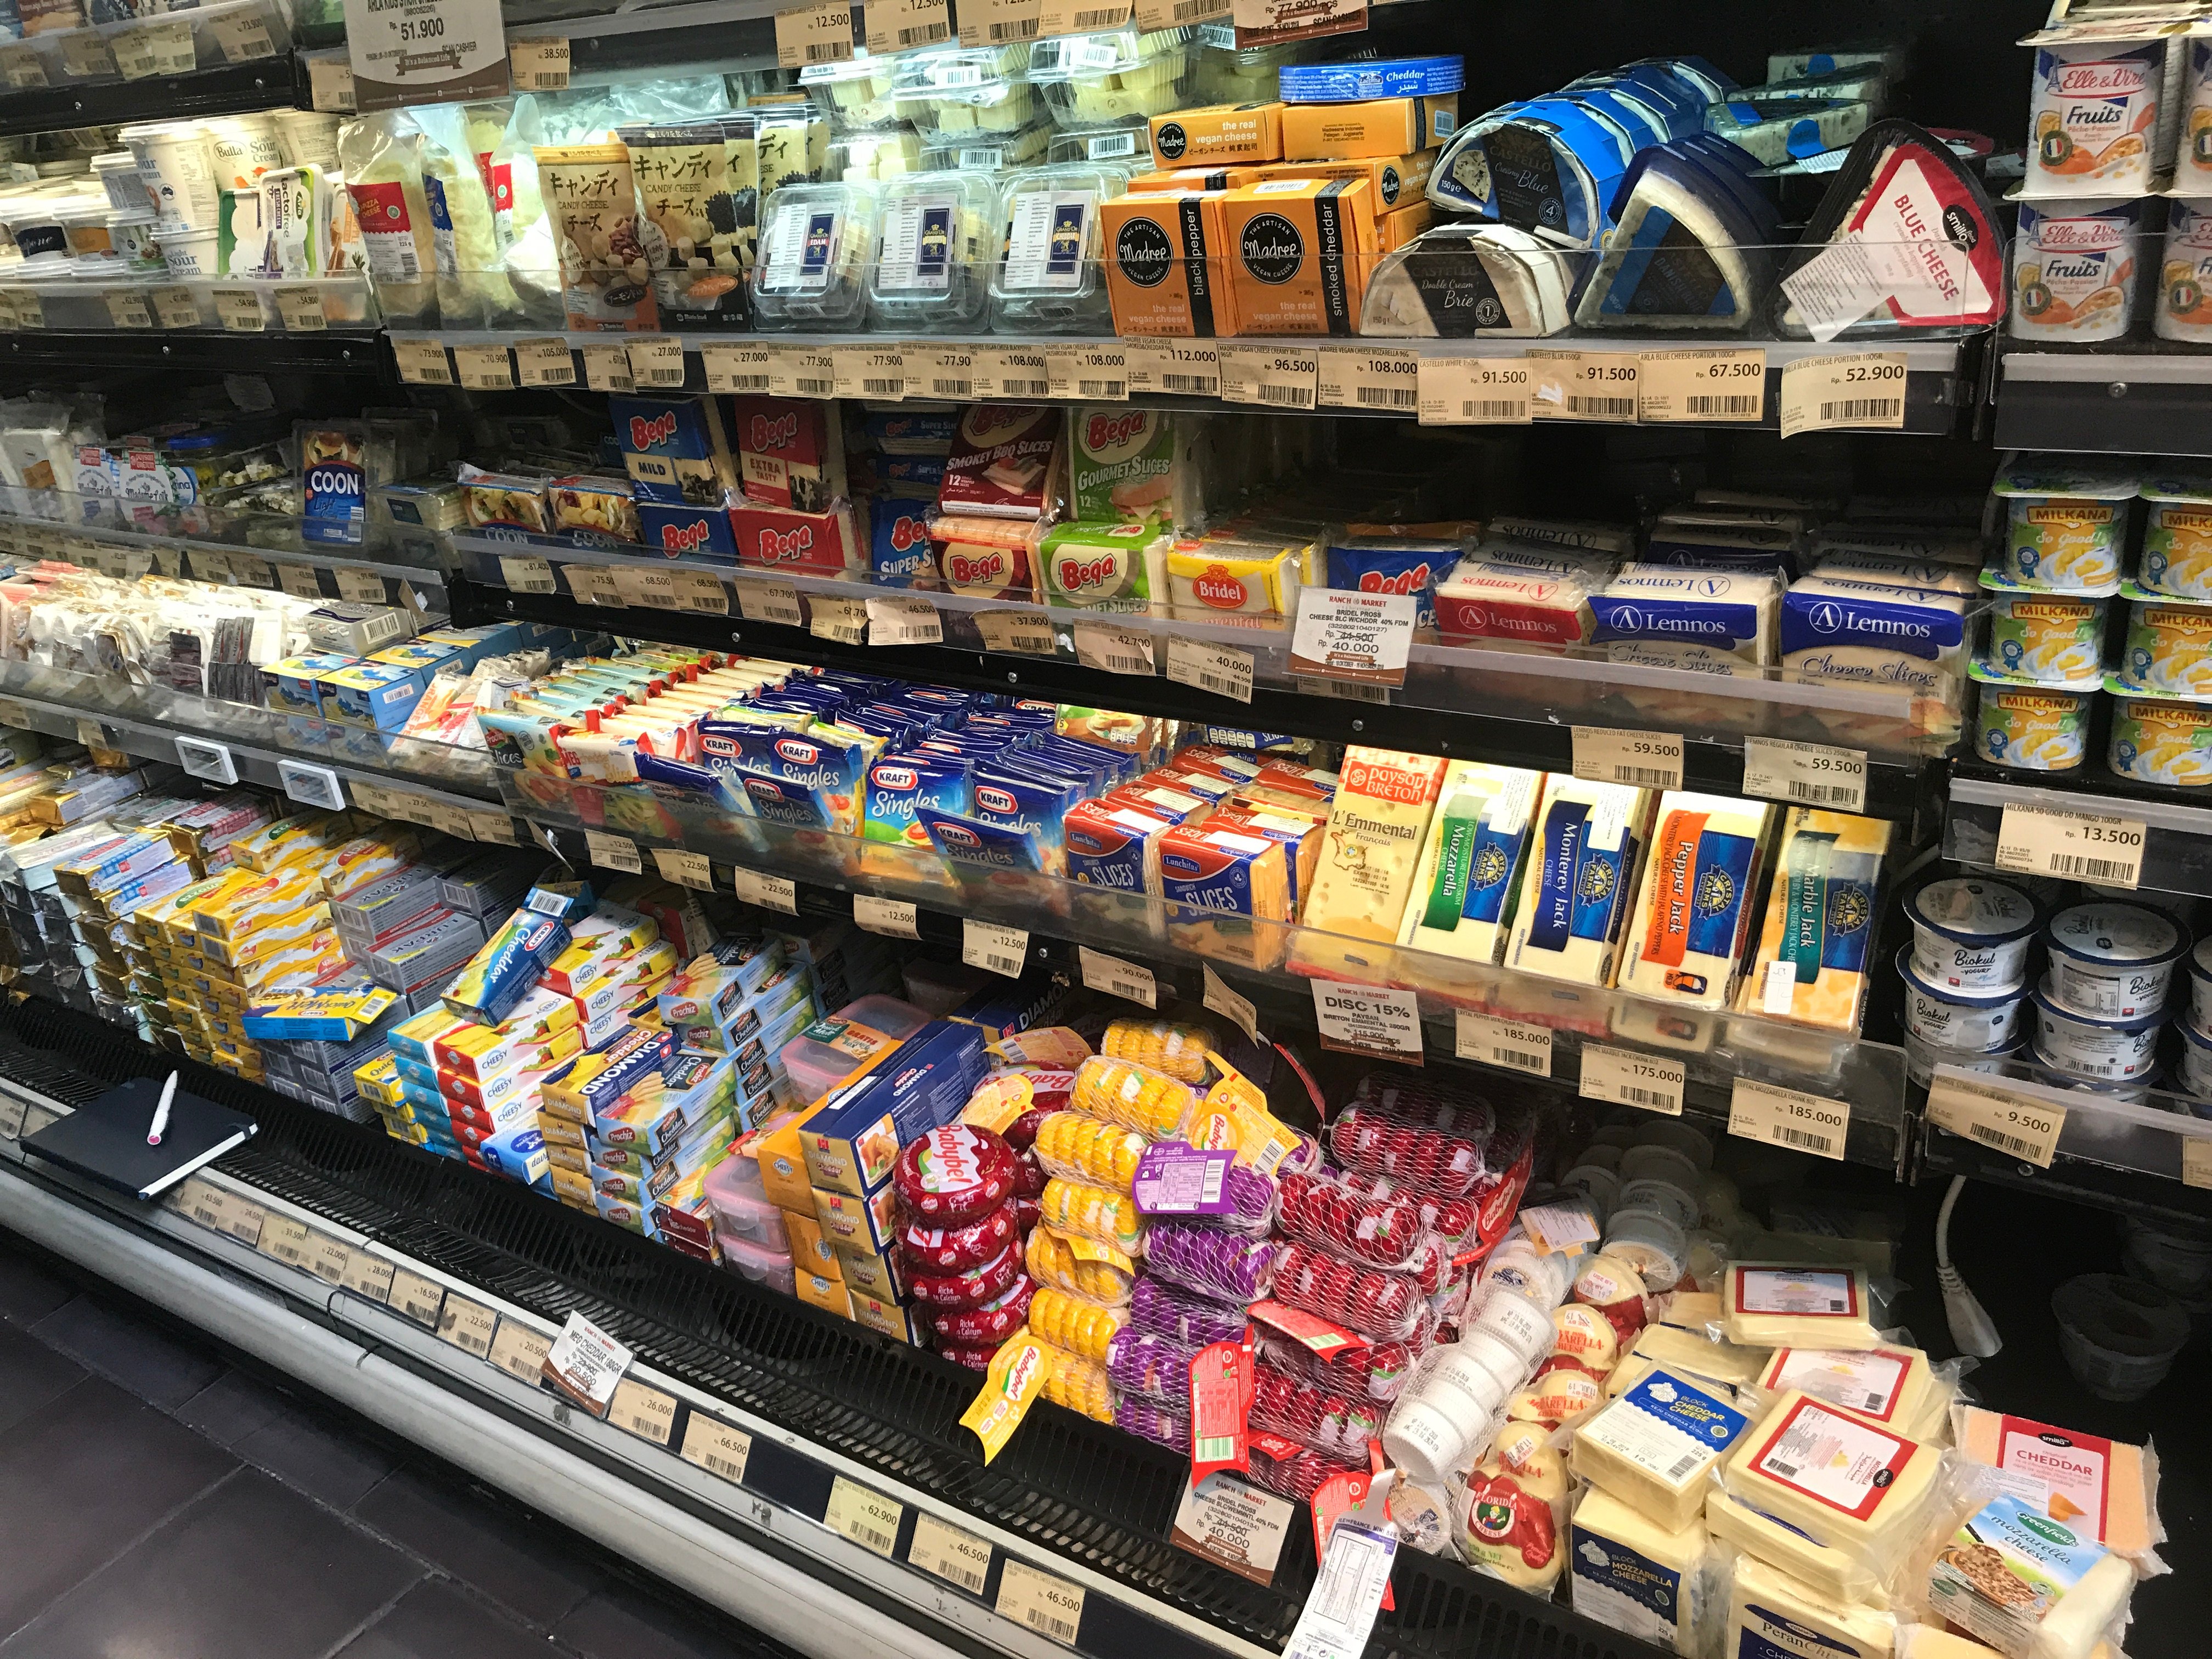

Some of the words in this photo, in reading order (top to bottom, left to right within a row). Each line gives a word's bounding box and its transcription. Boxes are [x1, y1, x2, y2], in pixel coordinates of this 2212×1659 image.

[400, 17, 444, 41] 51.900
[815, 13, 849, 27] 12.500
[544, 48, 568, 59] 38.500
[1386, 70, 1425, 81] Cheddar
[2067, 105, 2123, 125] Fruits
[1222, 120, 1237, 129] the
[1239, 120, 1257, 129] real
[1158, 136, 1184, 148] Madree
[1195, 133, 1223, 144] vegan
[1224, 131, 1257, 141] cheese
[216, 141, 243, 156] Bulla
[634, 151, 712, 180] キャンディ
[550, 172, 620, 196] キャンディ
[646, 184, 672, 193] CANDY
[675, 184, 701, 192] CHEESE
[1519, 171, 1548, 194] Blue
[657, 198, 695, 217] チーズ
[568, 213, 602, 231] チーズ
[1186, 210, 1204, 257] pepper
[1323, 204, 1341, 261] cheddar
[1119, 240, 1171, 260] Madree
[1894, 194, 1923, 238] BLUE
[1918, 236, 1960, 301] CHEESE
[168, 255, 198, 267] Sour
[2046, 259, 2100, 278] Fruits
[1185, 257, 1204, 296] black
[1422, 279, 1446, 290] Double
[1449, 280, 1474, 290] Cream
[1323, 263, 1343, 316] smoked
[1444, 291, 1474, 308] Brie
[423, 349, 443, 359] 73.900
[486, 355, 507, 363] 70.900
[542, 347, 569, 357] 105.000
[741, 352, 768, 362] 27.000
[873, 356, 902, 366] 77.900
[1008, 355, 1043, 367] 108.000
[1170, 349, 1216, 362] 112.000
[1274, 358, 1314, 373] 96.500
[1368, 360, 1417, 374] 108.000
[1587, 367, 1636, 381] 91.500
[1709, 363, 1760, 377] 67.500
[1846, 365, 1904, 381] 52.900
[1482, 371, 1527, 383] 91.500
[630, 410, 676, 451] Bega
[638, 461, 665, 476] MILD
[750, 458, 781, 475] EXTRA
[311, 471, 358, 495] COON
[755, 471, 777, 482] TASTY
[2036, 509, 2107, 521] MILKANA
[1059, 554, 1116, 590] Bega
[1198, 579, 1242, 601] Bridel
[1361, 599, 1386, 607] MARKET
[2019, 605, 2090, 617] MILKANA
[1017, 617, 1047, 626] 37.900
[1328, 623, 1387, 633] (3228021040127)
[1491, 614, 1556, 634] Lemnos
[1645, 614, 1726, 634] Lemnos
[1847, 611, 1931, 639] Lemnos
[1332, 642, 1379, 653] 40.000
[1217, 656, 1251, 674] 40.000
[1801, 655, 1873, 678] Cheese
[1881, 662, 1937, 686] Slices
[2006, 697, 2073, 709] MILKANA
[2135, 708, 2207, 723] MILKANA
[705, 740, 737, 754] KRAFT
[782, 744, 813, 759] KRAFT
[1634, 742, 1679, 757] 59.500
[1811, 758, 1862, 775] 59.500
[782, 764, 839, 788] Singles
[878, 770, 913, 786] KRAFT
[872, 791, 940, 817] Singles
[979, 792, 1014, 809] KRAFT
[1332, 810, 1417, 840] L'Emmental
[1071, 834, 1101, 848] Lunchitas
[1356, 832, 1391, 845] Français
[2083, 827, 2141, 845] 13.500
[1165, 857, 1199, 871] Lunchitas
[1442, 825, 1459, 896] Mozzarella
[1556, 822, 1578, 893] Monterey
[1093, 864, 1134, 886] SLICES
[1673, 840, 1694, 896] Pepper
[768, 884, 792, 896] 22.500
[1803, 864, 1819, 912] Marble
[889, 912, 915, 923] 12.500
[1553, 898, 1568, 928] Jack
[1668, 899, 1687, 934] Jack
[1799, 916, 1815, 947] Jack
[1000, 937, 1025, 950] 12.500
[488, 928, 532, 983] Cheddar
[1954, 950, 1996, 966] Biokul
[575, 965, 598, 985] CHEESY
[1122, 968, 1153, 981] 90.000
[670, 1005, 696, 1015] Prochiz
[1325, 996, 1367, 1011] DISC
[1373, 1004, 1410, 1018] 15%
[1917, 999, 1950, 1023] Biokul
[1504, 1028, 1549, 1046] 185.000
[482, 1051, 507, 1071] CHEESY
[580, 1041, 661, 1097] DIAMOND
[1633, 1064, 1682, 1084] 175.000
[487, 1077, 512, 1098] CHEESY
[1736, 1081, 1754, 1091] CRYTAL
[1755, 1086, 1787, 1098] MOZZARELLA
[1788, 1094, 1805, 1103] CHUNK
[546, 1098, 582, 1114] DIAMOND
[1788, 1105, 1841, 1126] 185.000
[2008, 1111, 2051, 1133] 9.500
[609, 1131, 633, 1141] Prochiz
[808, 1150, 847, 1166] DIAMOND
[936, 1126, 973, 1183] Babybel
[371, 1265, 392, 1279] 28.000
[470, 1315, 492, 1331] 22.500
[523, 1341, 547, 1358] 20.500
[568, 1330, 581, 1344] MEG
[580, 1336, 605, 1362] CHEDDAR
[604, 1357, 622, 1374] 180GR
[1010, 1346, 1036, 1400] Babybel
[647, 1400, 672, 1416] 26.000
[1674, 1401, 1725, 1420] CHEDDAR
[1681, 1396, 1708, 1408] BLOCK
[1669, 1406, 1710, 1422] CHEESE
[720, 1436, 747, 1455] 66.500
[2017, 1450, 2092, 1476] CHEDDAR
[1216, 1481, 1235, 1493] RANCH
[1244, 1492, 1267, 1506] MARKET
[1476, 1492, 1517, 1510] FLORIDIA
[1217, 1494, 1236, 1507] BRIDEL
[1238, 1503, 1256, 1514] PROSS
[868, 1505, 896, 1525] 62.900
[1209, 1526, 1250, 1549] 40.000
[2017, 1510, 2079, 1547] Greenfields
[1992, 1515, 2070, 1565] mozzarella
[2004, 1535, 2049, 1562] cheese
[957, 1543, 988, 1564] 46.500
[1612, 1554, 1636, 1565] BLOCK
[1612, 1562, 1672, 1588] MOZZARELLA
[1613, 1571, 1647, 1585] CHEESE
[1047, 1590, 1080, 1612] 46.500
